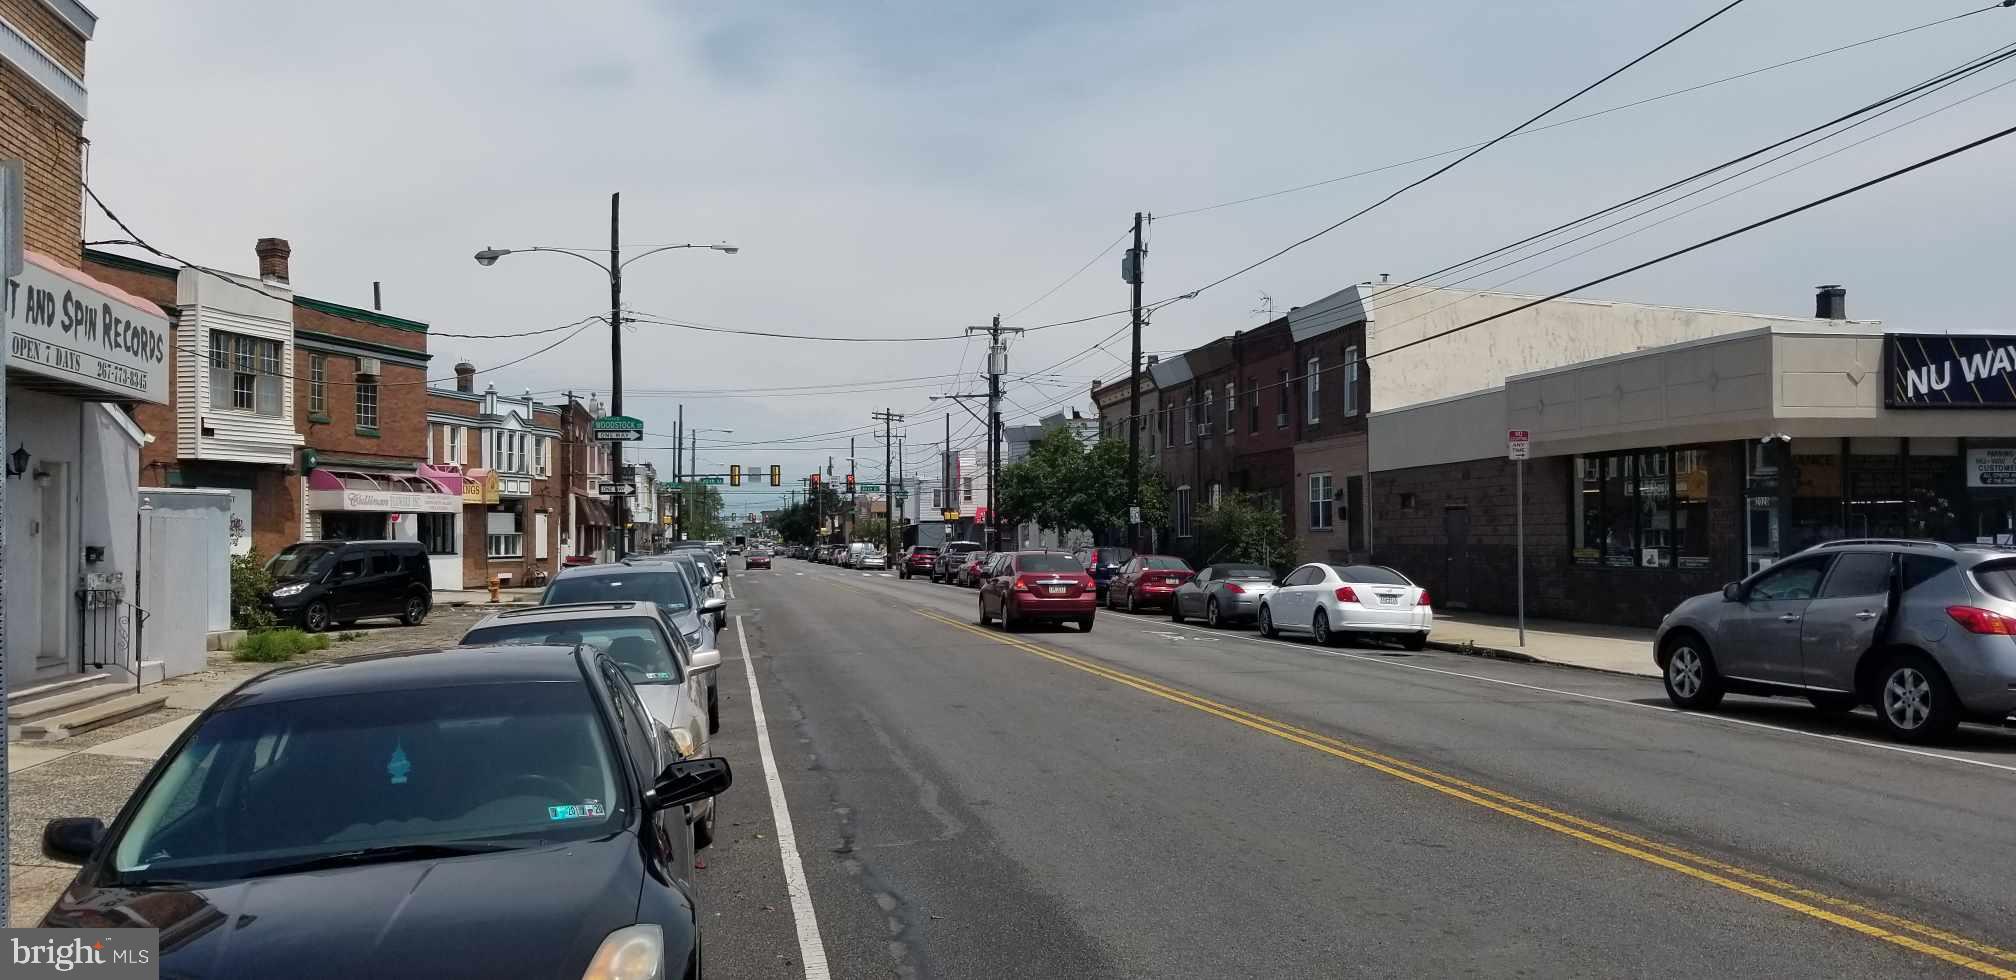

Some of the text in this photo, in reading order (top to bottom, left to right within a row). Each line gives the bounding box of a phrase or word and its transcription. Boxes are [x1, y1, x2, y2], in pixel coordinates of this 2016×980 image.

[26, 285, 55, 328] AND
[61, 289, 97, 342] SPIN
[102, 302, 164, 364] RECORDS
[12, 336, 148, 390] OPEN 7 DAYS 267-773-8345
[1907, 360, 1951, 398] NU
[596, 421, 635, 429] WOODSTOCK
